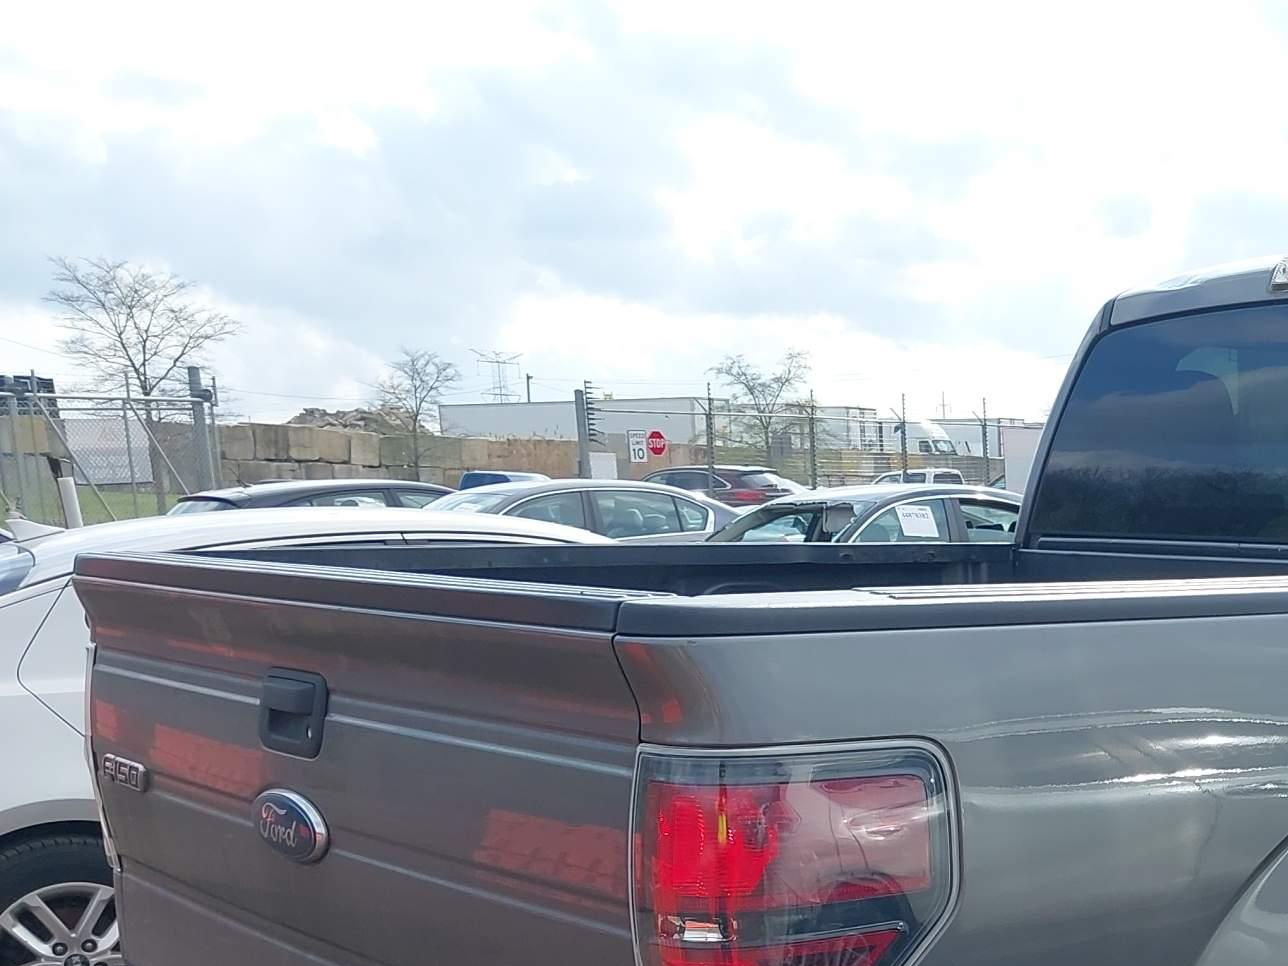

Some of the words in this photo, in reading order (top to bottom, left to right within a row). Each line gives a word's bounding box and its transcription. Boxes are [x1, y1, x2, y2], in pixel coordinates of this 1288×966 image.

[648, 438, 666, 449] STOP
[632, 447, 645, 460] 10
[260, 802, 297, 847] Ford
